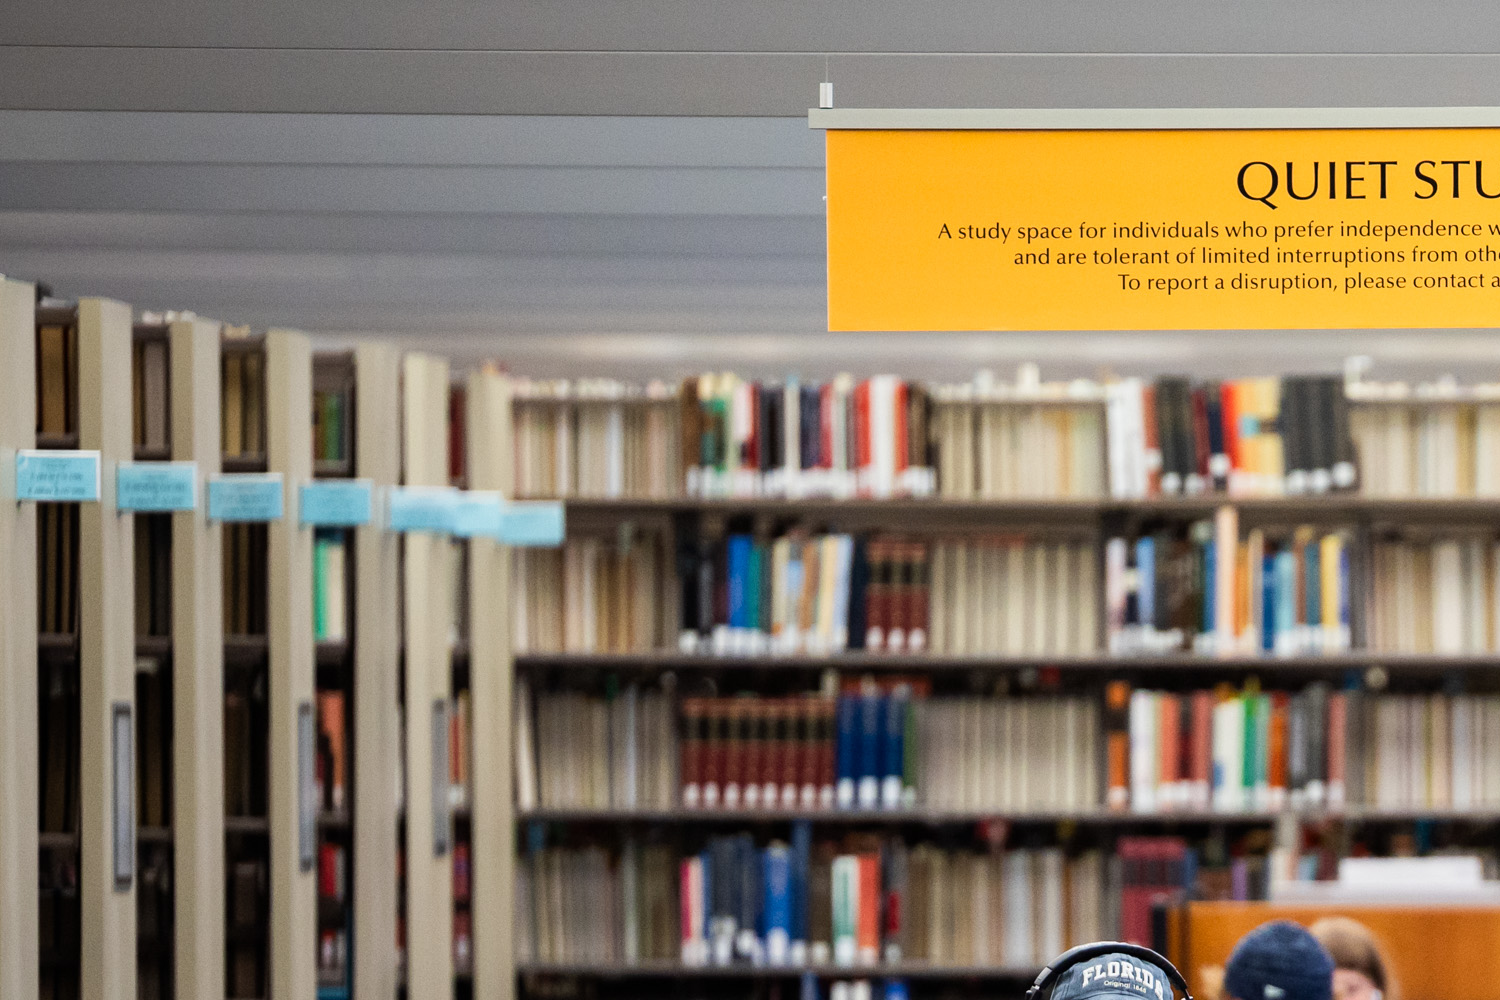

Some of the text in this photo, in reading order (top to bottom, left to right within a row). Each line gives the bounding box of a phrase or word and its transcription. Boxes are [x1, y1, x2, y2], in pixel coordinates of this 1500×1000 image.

[1237, 161, 1397, 210] QUIET
[938, 224, 952, 239] A
[959, 223, 1011, 244] study
[1018, 227, 1072, 244] space
[1080, 222, 1106, 238] for
[1114, 221, 1218, 238] individuals
[1225, 221, 1267, 237] who
[1275, 220, 1334, 243] prefer
[1341, 220, 1481, 242] independence
[1015, 248, 1049, 264] and
[1057, 253, 1086, 264] are
[1094, 248, 1169, 264] tolerant
[1177, 247, 1197, 264] of
[1203, 247, 1269, 263] limited
[1278, 247, 1404, 268] interruptions
[1413, 246, 1457, 262] from
[1118, 275, 1140, 290] To
[1148, 275, 1208, 296] report
[1215, 278, 1224, 289] a
[1231, 273, 1337, 294] disruption,
[1345, 272, 1406, 294] please
[1414, 273, 1484, 289] contact
[1492, 276, 1500, 287] a
[1103, 980, 1131, 989] Original
